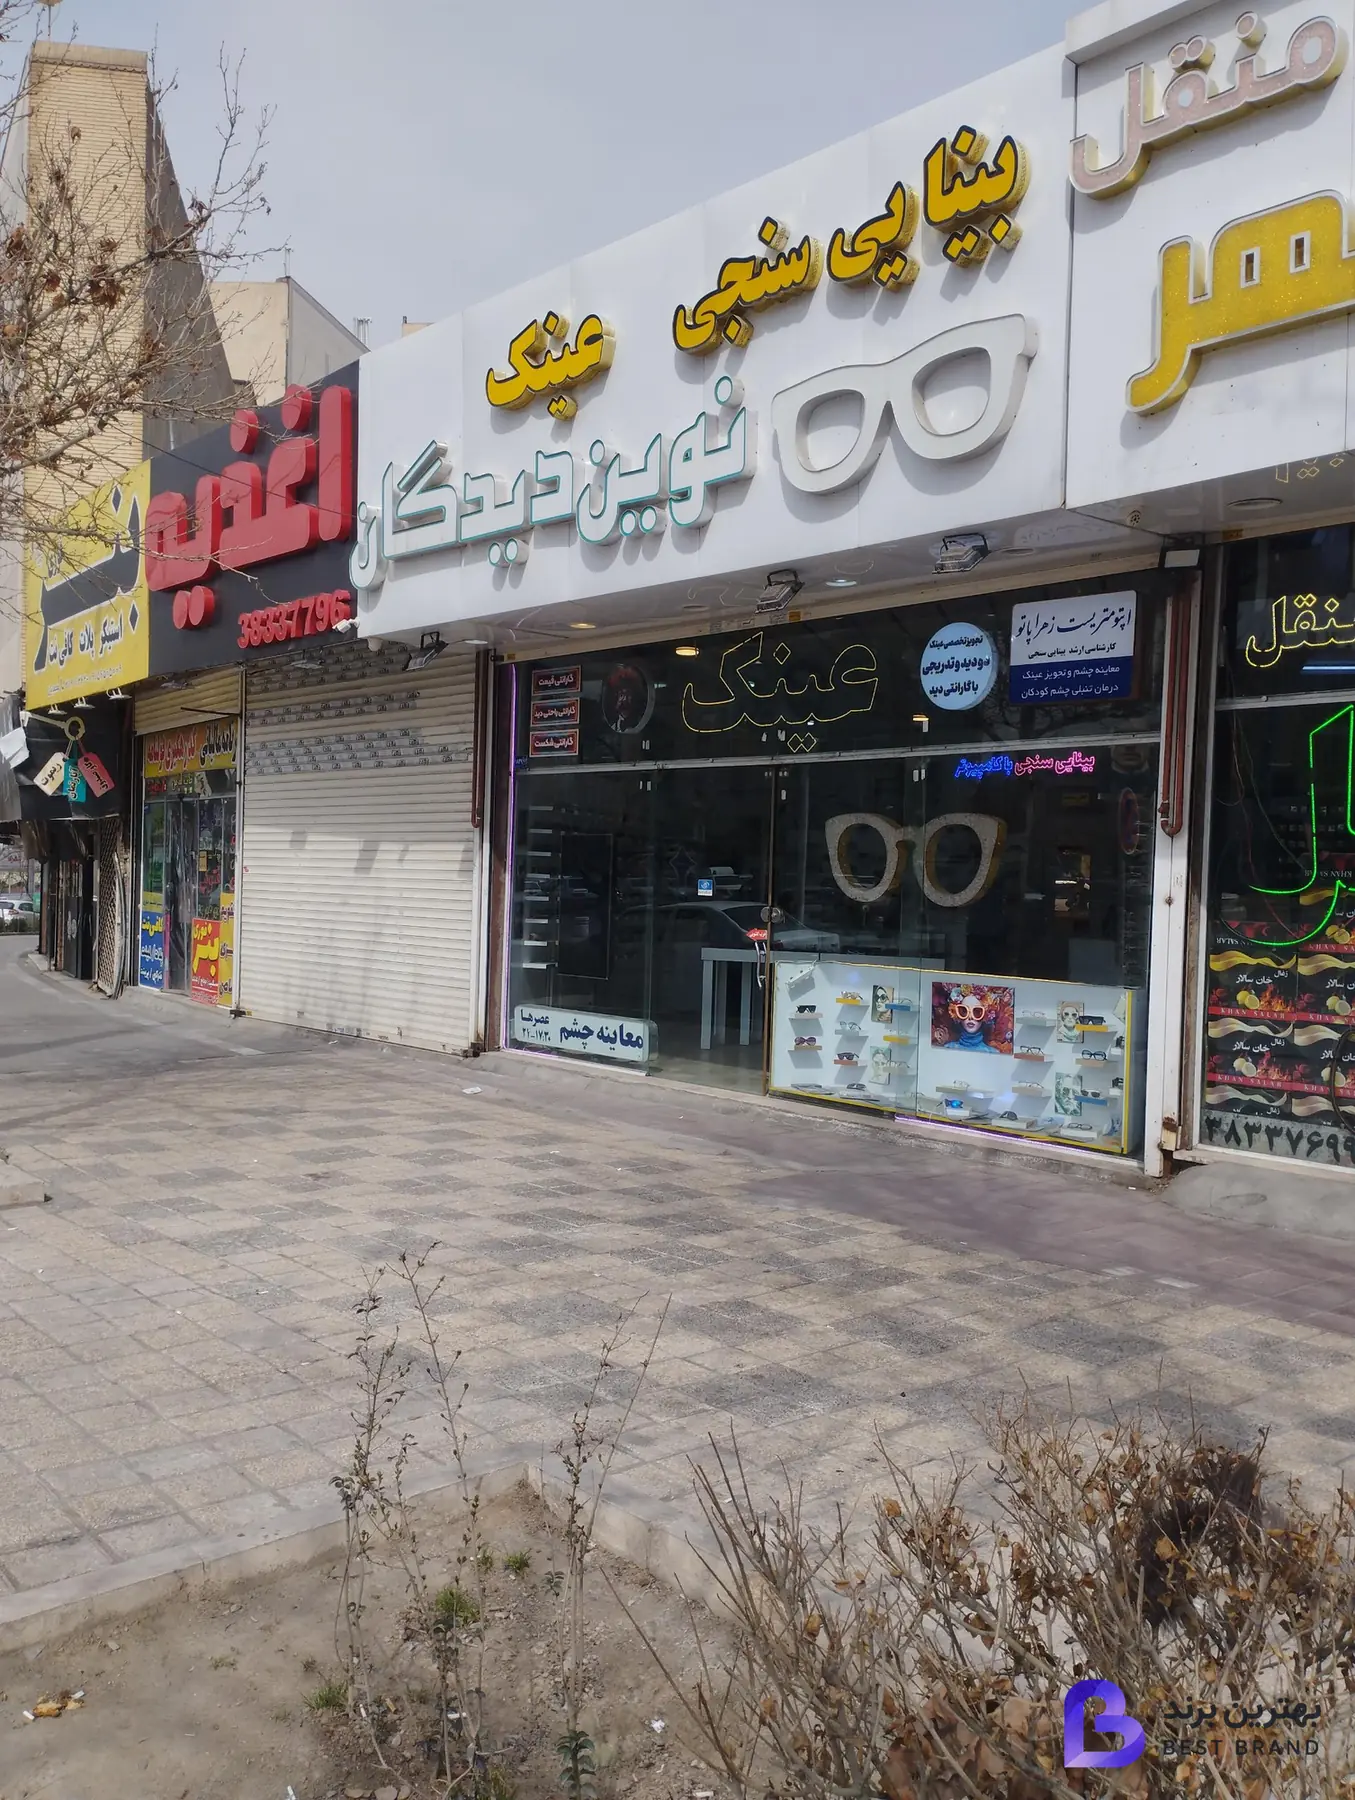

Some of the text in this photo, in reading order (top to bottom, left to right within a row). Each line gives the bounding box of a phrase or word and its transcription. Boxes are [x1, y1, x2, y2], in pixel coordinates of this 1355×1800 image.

[1069, 11, 1348, 199] منقل
[672, 125, 1031, 355] بینایی سنجی
[486, 310, 614, 421] عینک
[349, 376, 753, 589] نوین دیدگان
[144, 383, 353, 629] اغذیه
[237, 590, 353, 649] 38337796
[1245, 593, 1355, 668] نقل
[929, 639, 944, 650] عینک
[1068, 645, 1085, 655] ارشد
[1085, 642, 1117, 655] کارشناسی
[1022, 671, 1043, 681] عینک
[1073, 667, 1094, 678] چشم
[1095, 665, 1120, 676] معاینه
[682, 631, 878, 752] عینک
[929, 685, 943, 698] دید
[1021, 687, 1049, 699] کودکان
[1050, 686, 1070, 697] چشم
[1094, 684, 1119, 694] درمان
[1014, 754, 1054, 776] سنجی
[1236, 974, 1273, 985] خان سالار
[1274, 969, 1289, 978] زغال
[520, 1009, 550, 1027] عصرها
[1220, 1007, 1285, 1019] KHAN SALAR
[560, 1018, 644, 1051] معاینه چشم
[1232, 1041, 1270, 1053] خان سالار
[1270, 1038, 1286, 1047] زغال
[1218, 1075, 1244, 1083] KHAN
